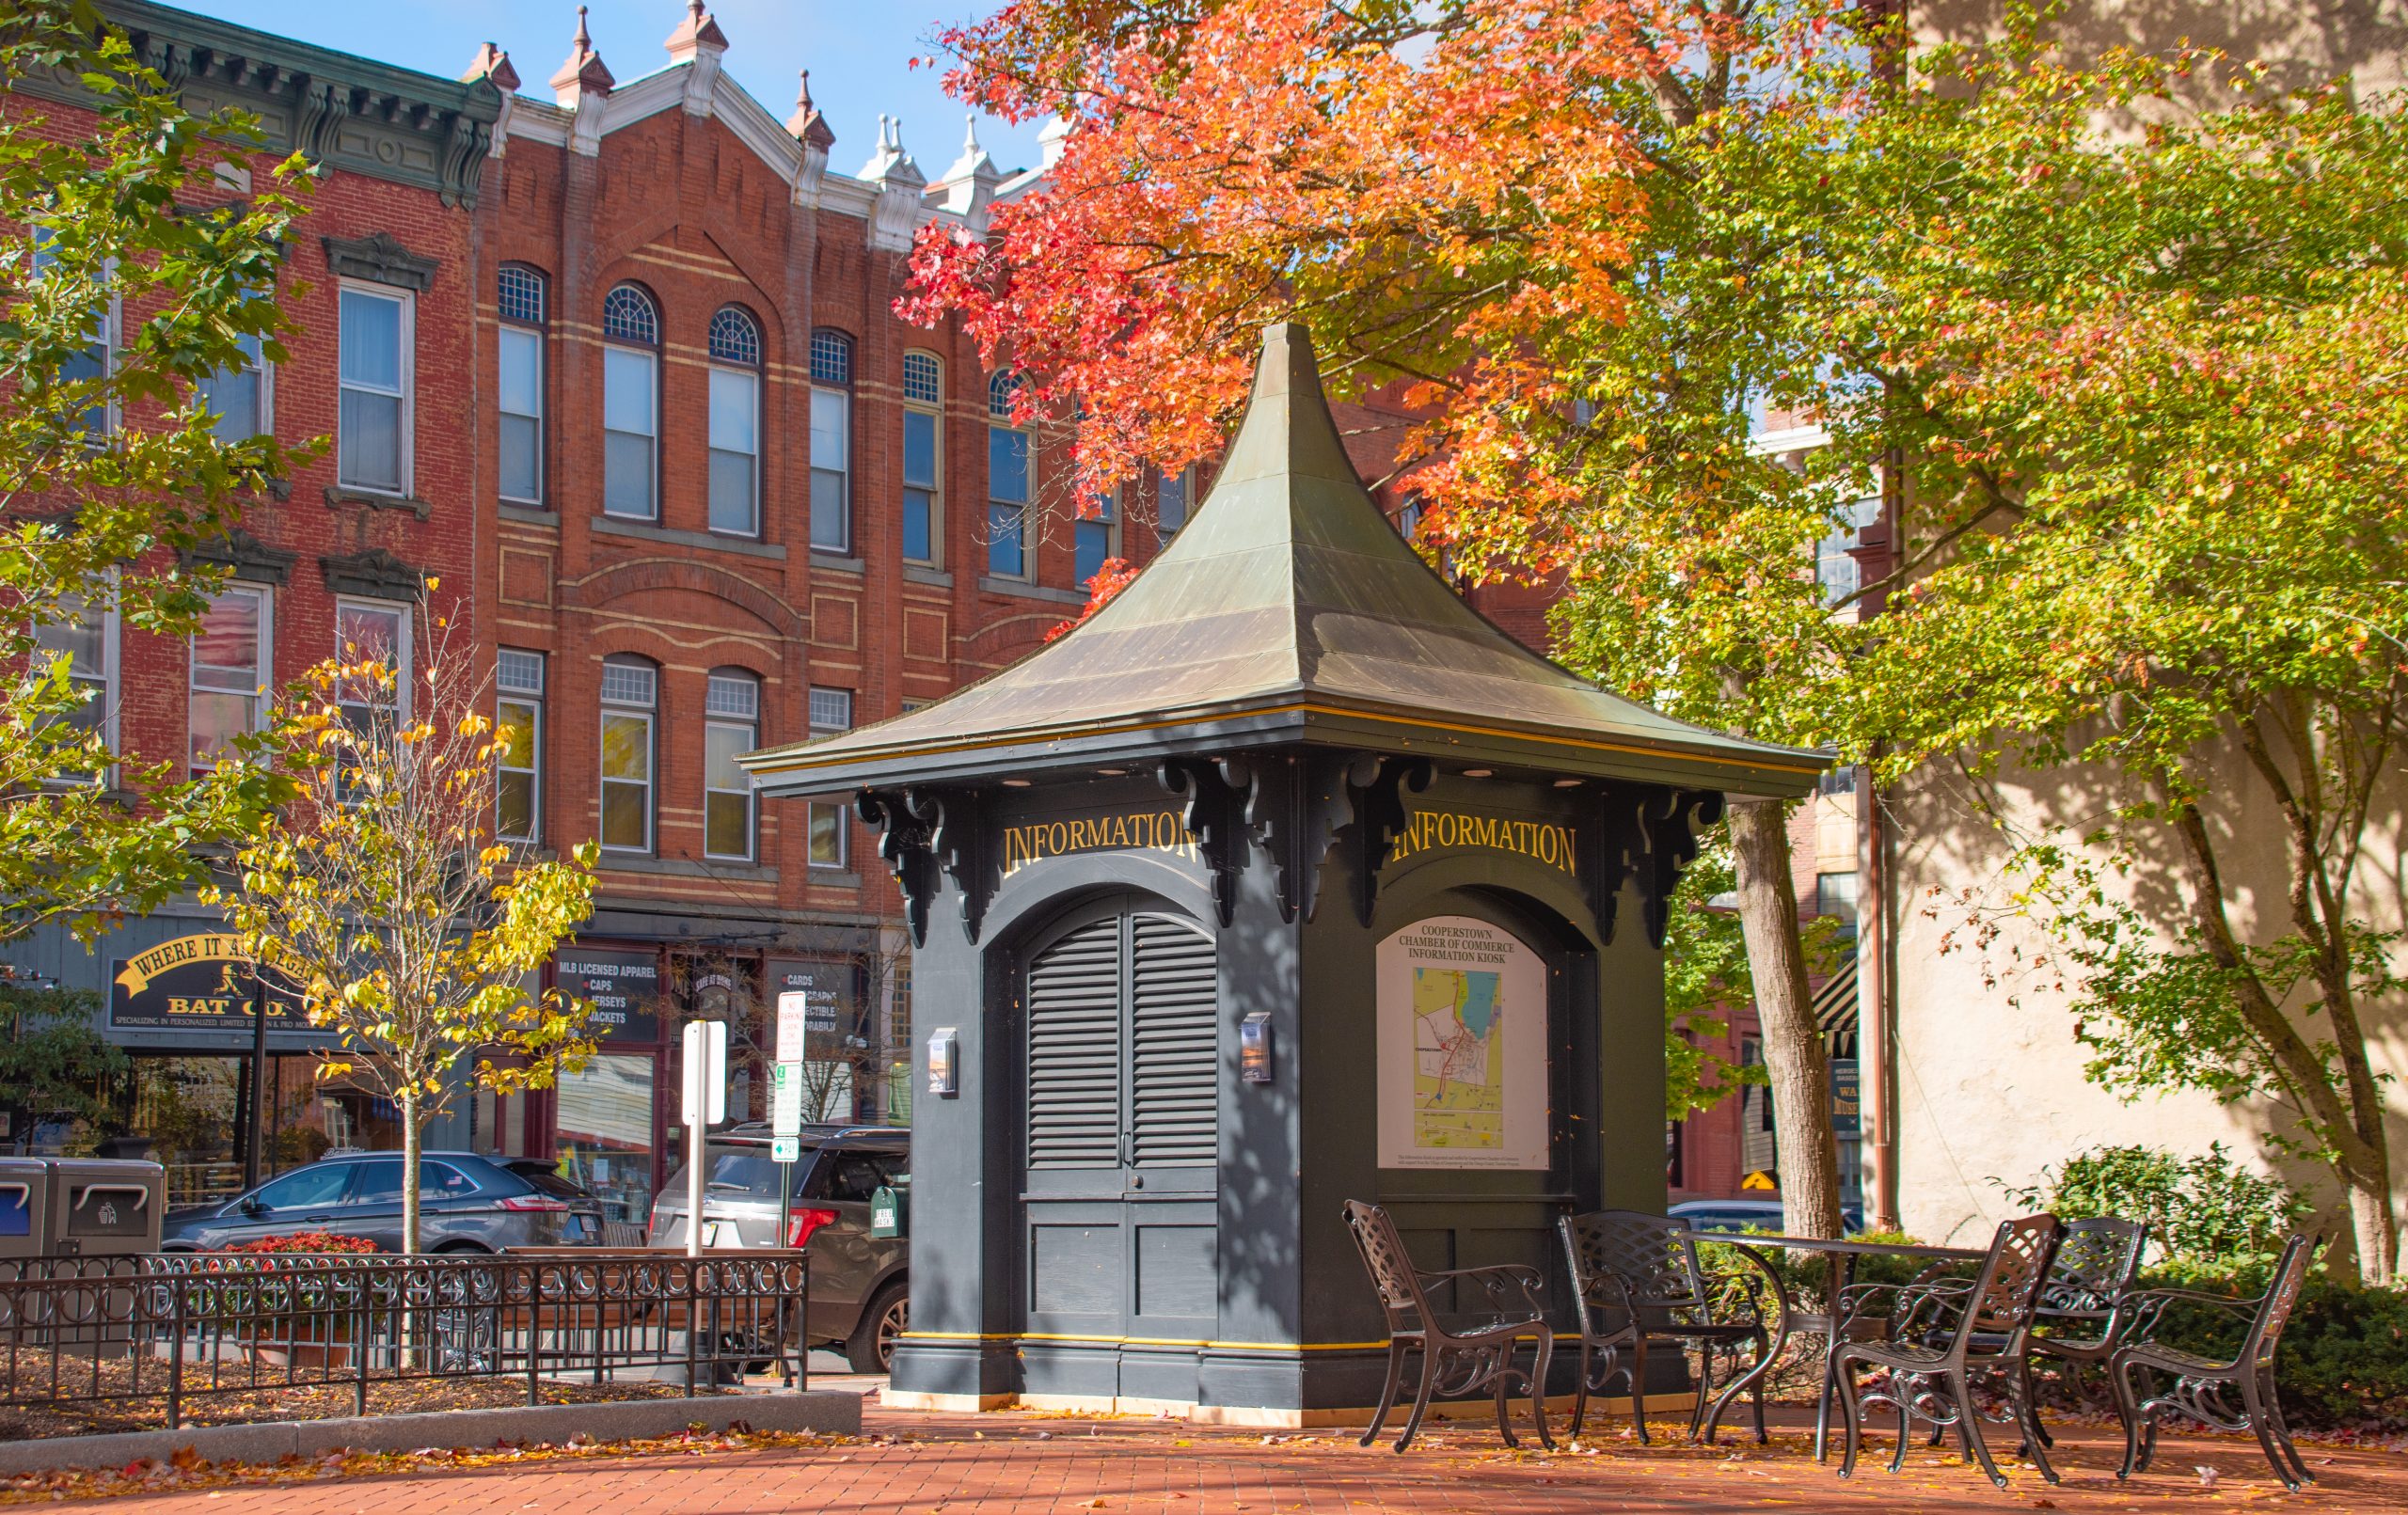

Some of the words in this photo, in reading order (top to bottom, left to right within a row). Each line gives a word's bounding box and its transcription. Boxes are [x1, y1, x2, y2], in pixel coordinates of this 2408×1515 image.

[1004, 812, 1197, 880] INFORMATION
[1392, 812, 1576, 877] INFORMATION
[1421, 925, 1493, 939] COOPERSTOWN
[1399, 935, 1446, 948] CHAMBER
[1448, 939, 1461, 949] OF
[1462, 940, 1514, 954] COMMERCE
[135, 939, 198, 977] WHERE
[204, 938, 221, 956] IT
[1408, 948, 1475, 962] INFORMATION
[1477, 953, 1506, 964] KIOSK
[559, 961, 578, 973] MLB
[578, 963, 619, 976] LICENSED
[620, 966, 657, 978] APPAREL
[590, 979, 612, 991] CAPS
[787, 974, 814, 986] CARDS
[167, 998, 230, 1015] BAT
[591, 995, 626, 1008] JERSEYS
[116, 1017, 159, 1025] SPECIALIZING
[589, 1011, 626, 1024] JACKETS
[1838, 1086, 1859, 1097] WA
[1833, 1096, 1860, 1115] MUSE
